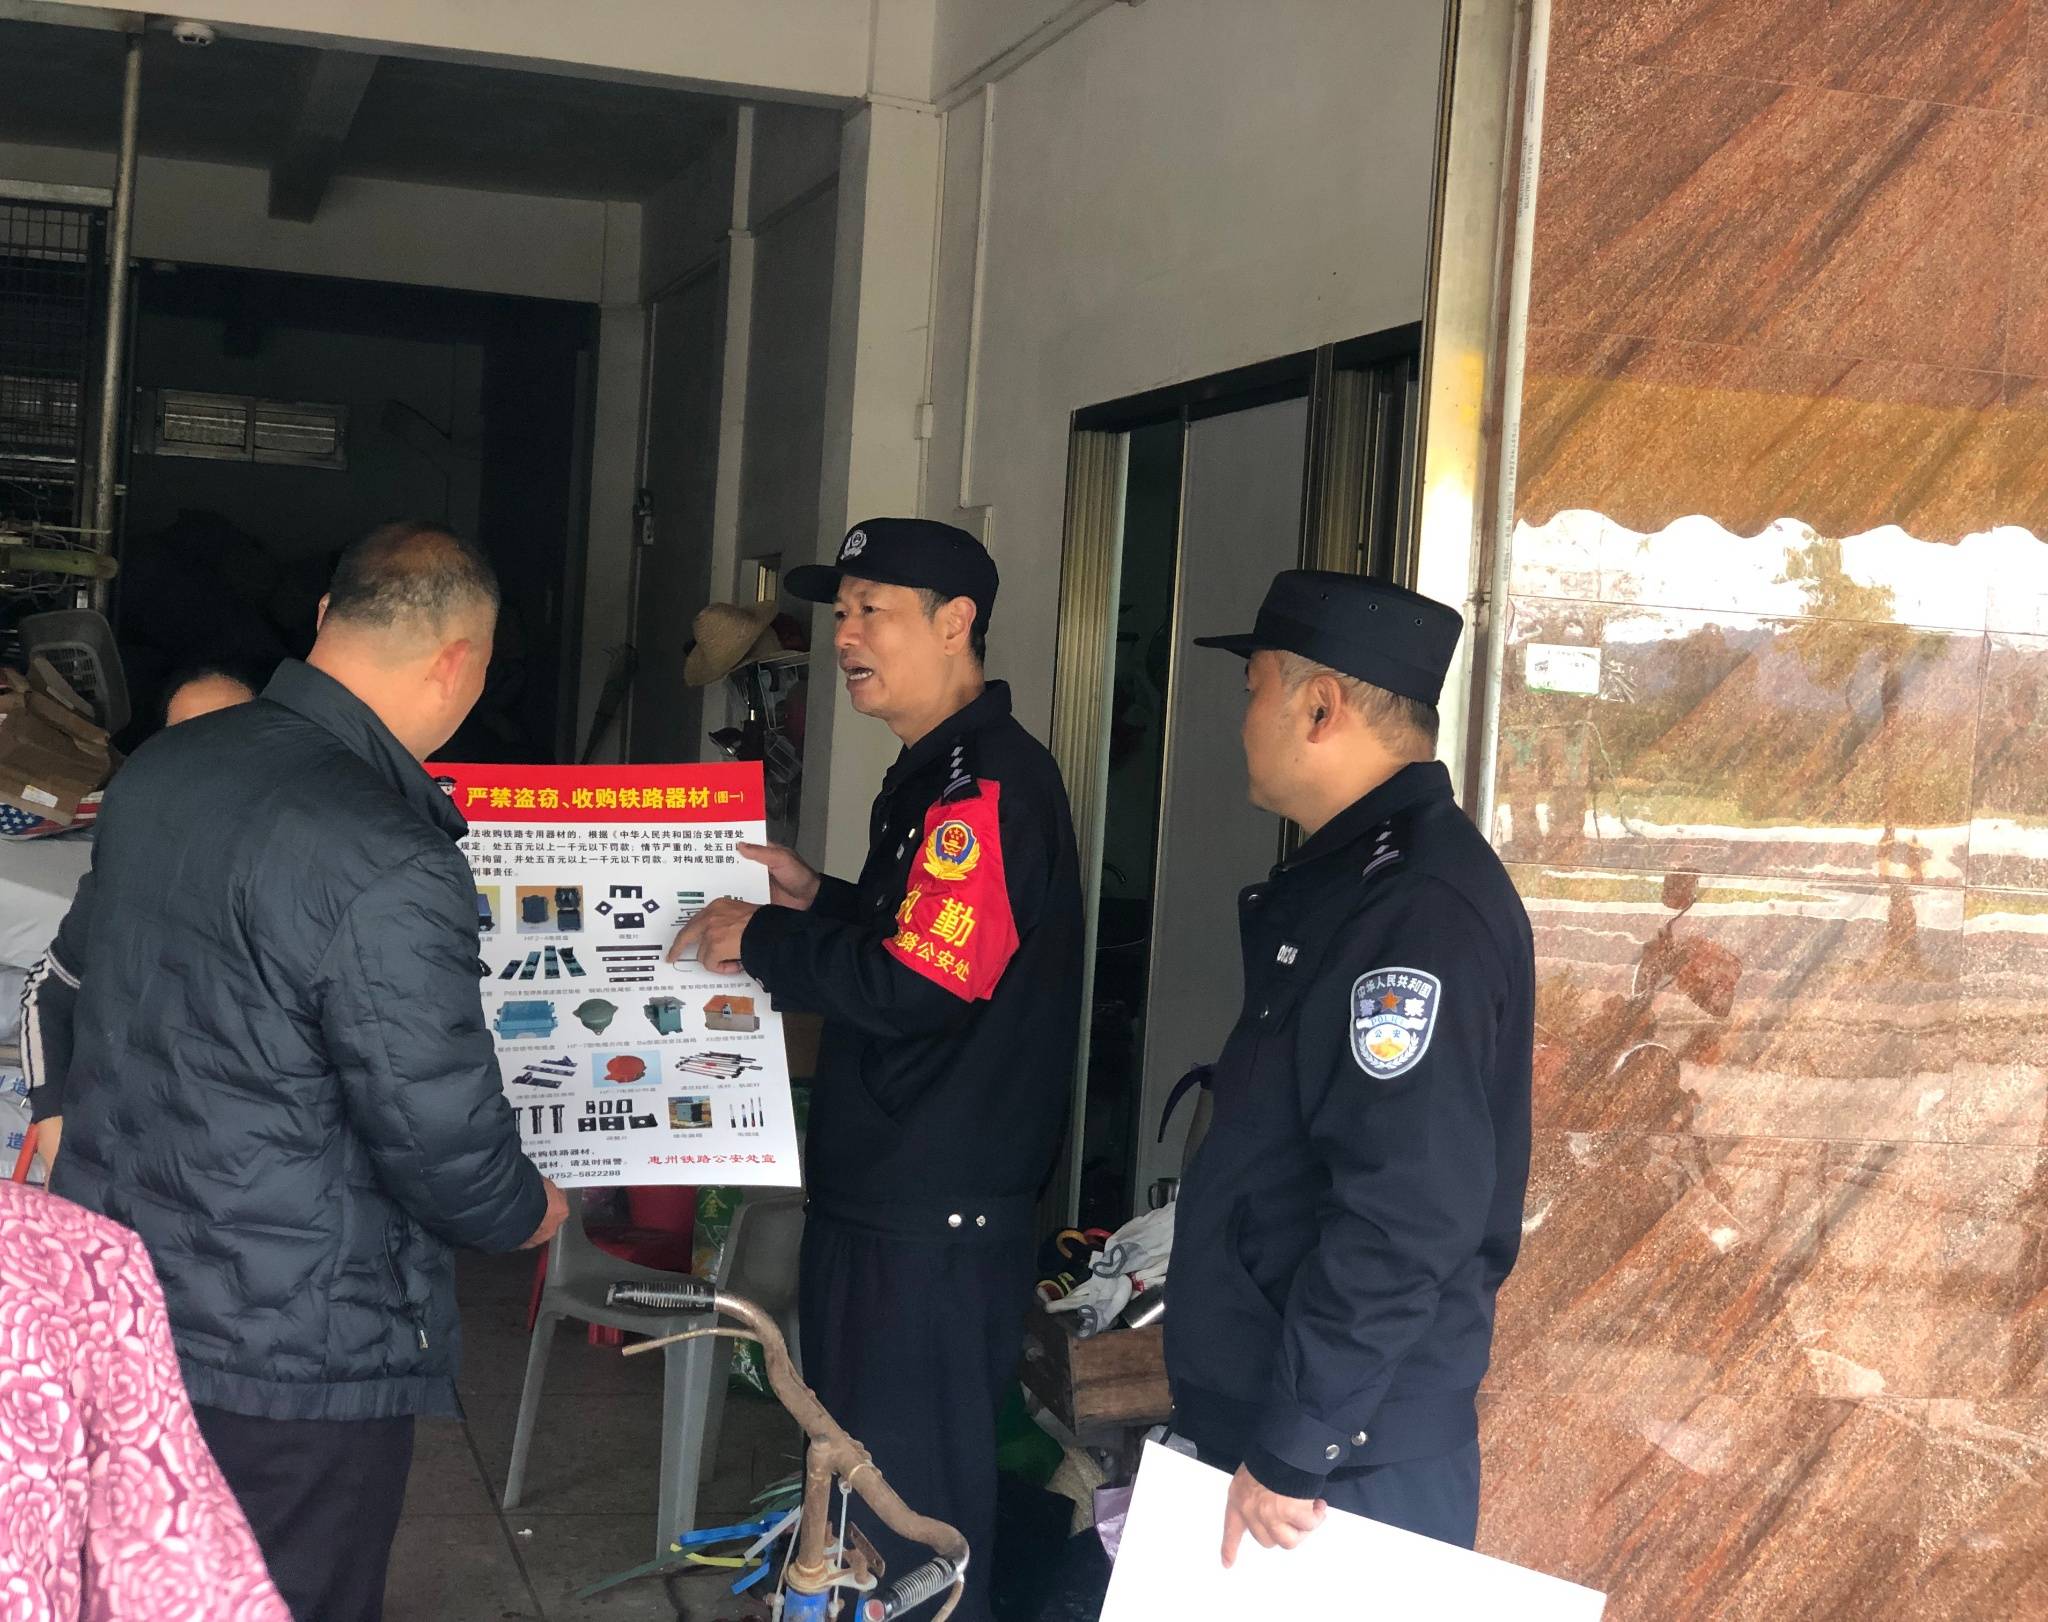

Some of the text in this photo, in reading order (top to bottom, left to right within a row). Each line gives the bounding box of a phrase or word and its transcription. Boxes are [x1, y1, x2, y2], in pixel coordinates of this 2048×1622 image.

[465, 787, 710, 809] 严禁盗窃、收购铁路器材
[466, 854, 740, 864] 下拘留，并处五百元以上一千元以下罚款。对构成犯罪的，
[893, 929, 970, 982] 路公安处
[1357, 974, 1433, 999] 中华人民共和国
